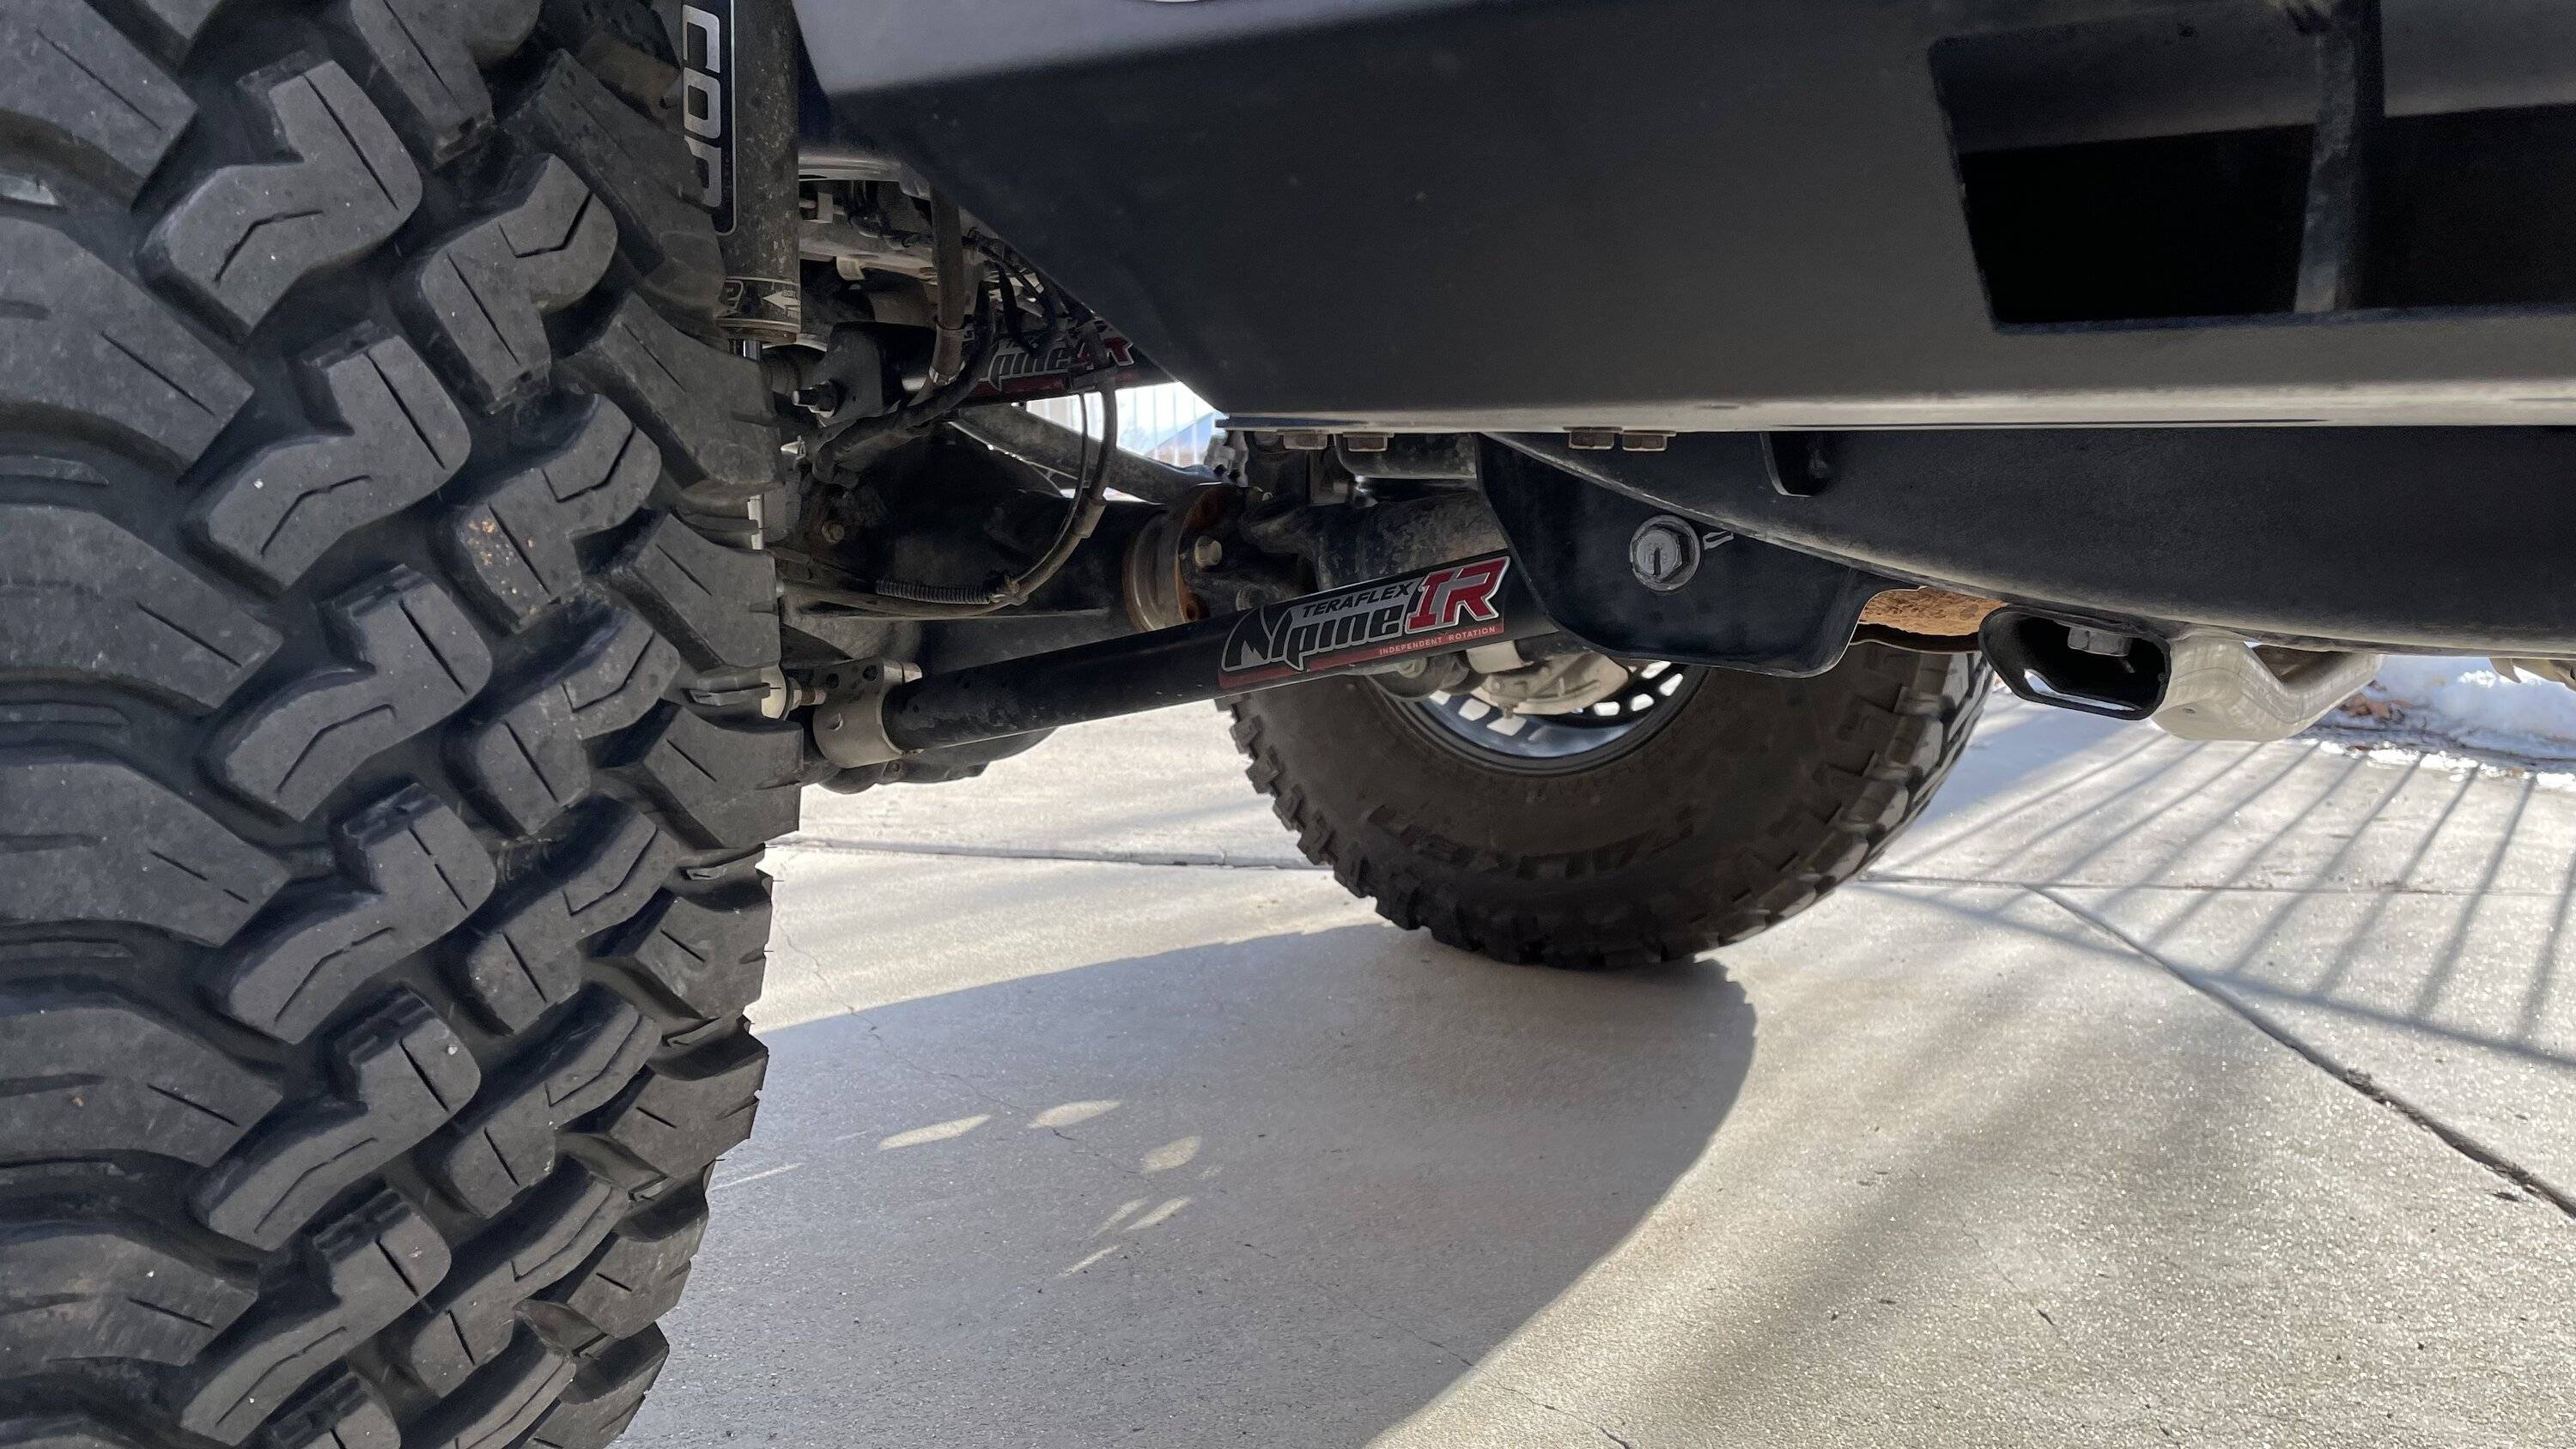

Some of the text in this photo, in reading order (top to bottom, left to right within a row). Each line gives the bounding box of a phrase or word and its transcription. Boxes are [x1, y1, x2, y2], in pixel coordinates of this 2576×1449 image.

[1303, 581, 1414, 618] TERAFLEX
[1379, 626, 1496, 655] INDEPENDENT ROTATION
